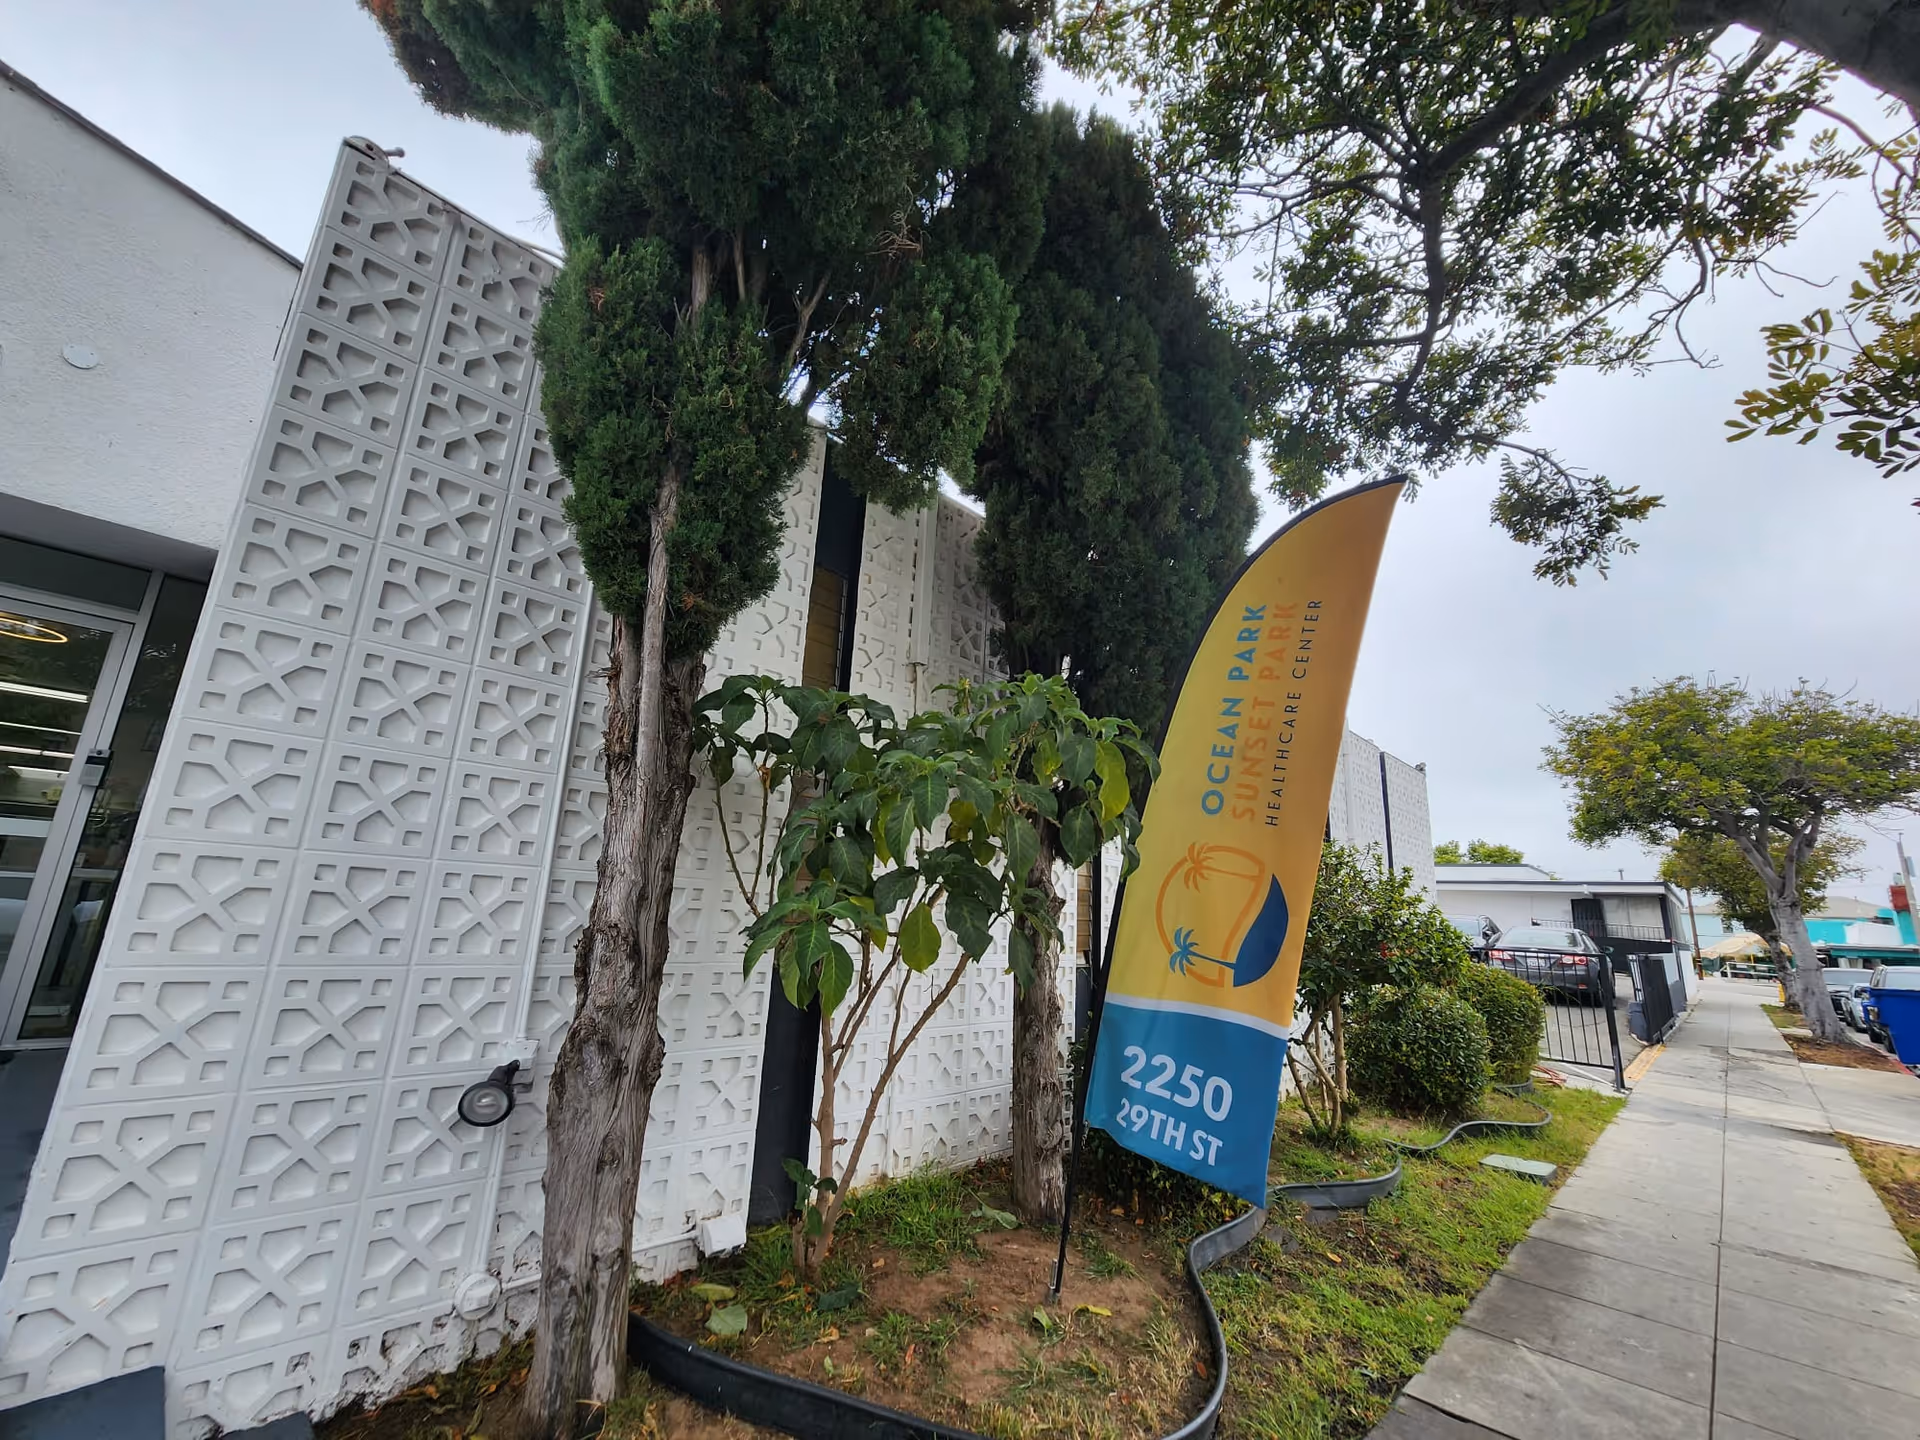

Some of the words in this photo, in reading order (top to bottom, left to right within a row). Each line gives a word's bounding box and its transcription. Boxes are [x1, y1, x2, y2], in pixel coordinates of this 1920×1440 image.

[1201, 697, 1244, 816] OCEAN
[1227, 604, 1267, 681] PARK
[1231, 696, 1275, 821] SUNSET
[1257, 601, 1298, 681] PARK
[1265, 691, 1302, 827] HEALTHCARE
[1292, 600, 1323, 679] CENTER
[1116, 1098, 1187, 1151] 29TH
[1189, 1130, 1223, 1166] ST
[1120, 1045, 1233, 1122] 2250
